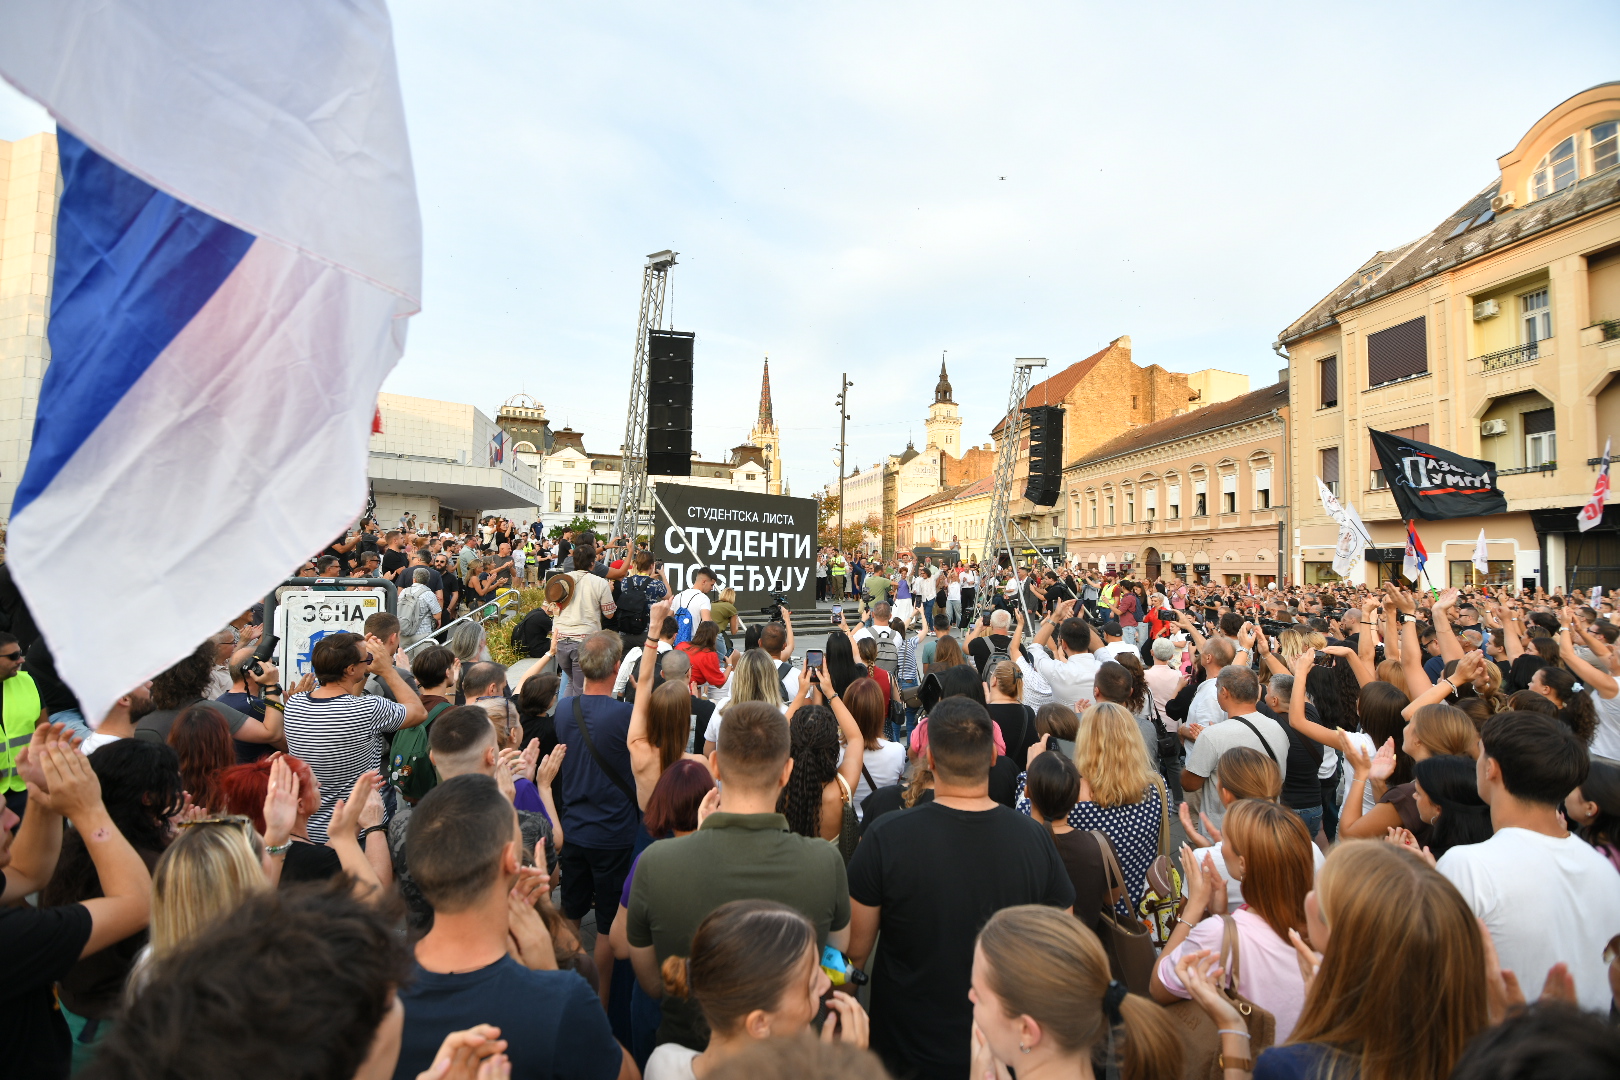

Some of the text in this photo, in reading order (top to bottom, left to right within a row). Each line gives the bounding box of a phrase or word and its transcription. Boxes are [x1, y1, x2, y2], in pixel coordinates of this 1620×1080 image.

[687, 506, 795, 525] СТУДЕНТСКА ЛИСТА
[664, 525, 811, 561] СТУДЕНТИ
[303, 604, 364, 622] ЗОНА
